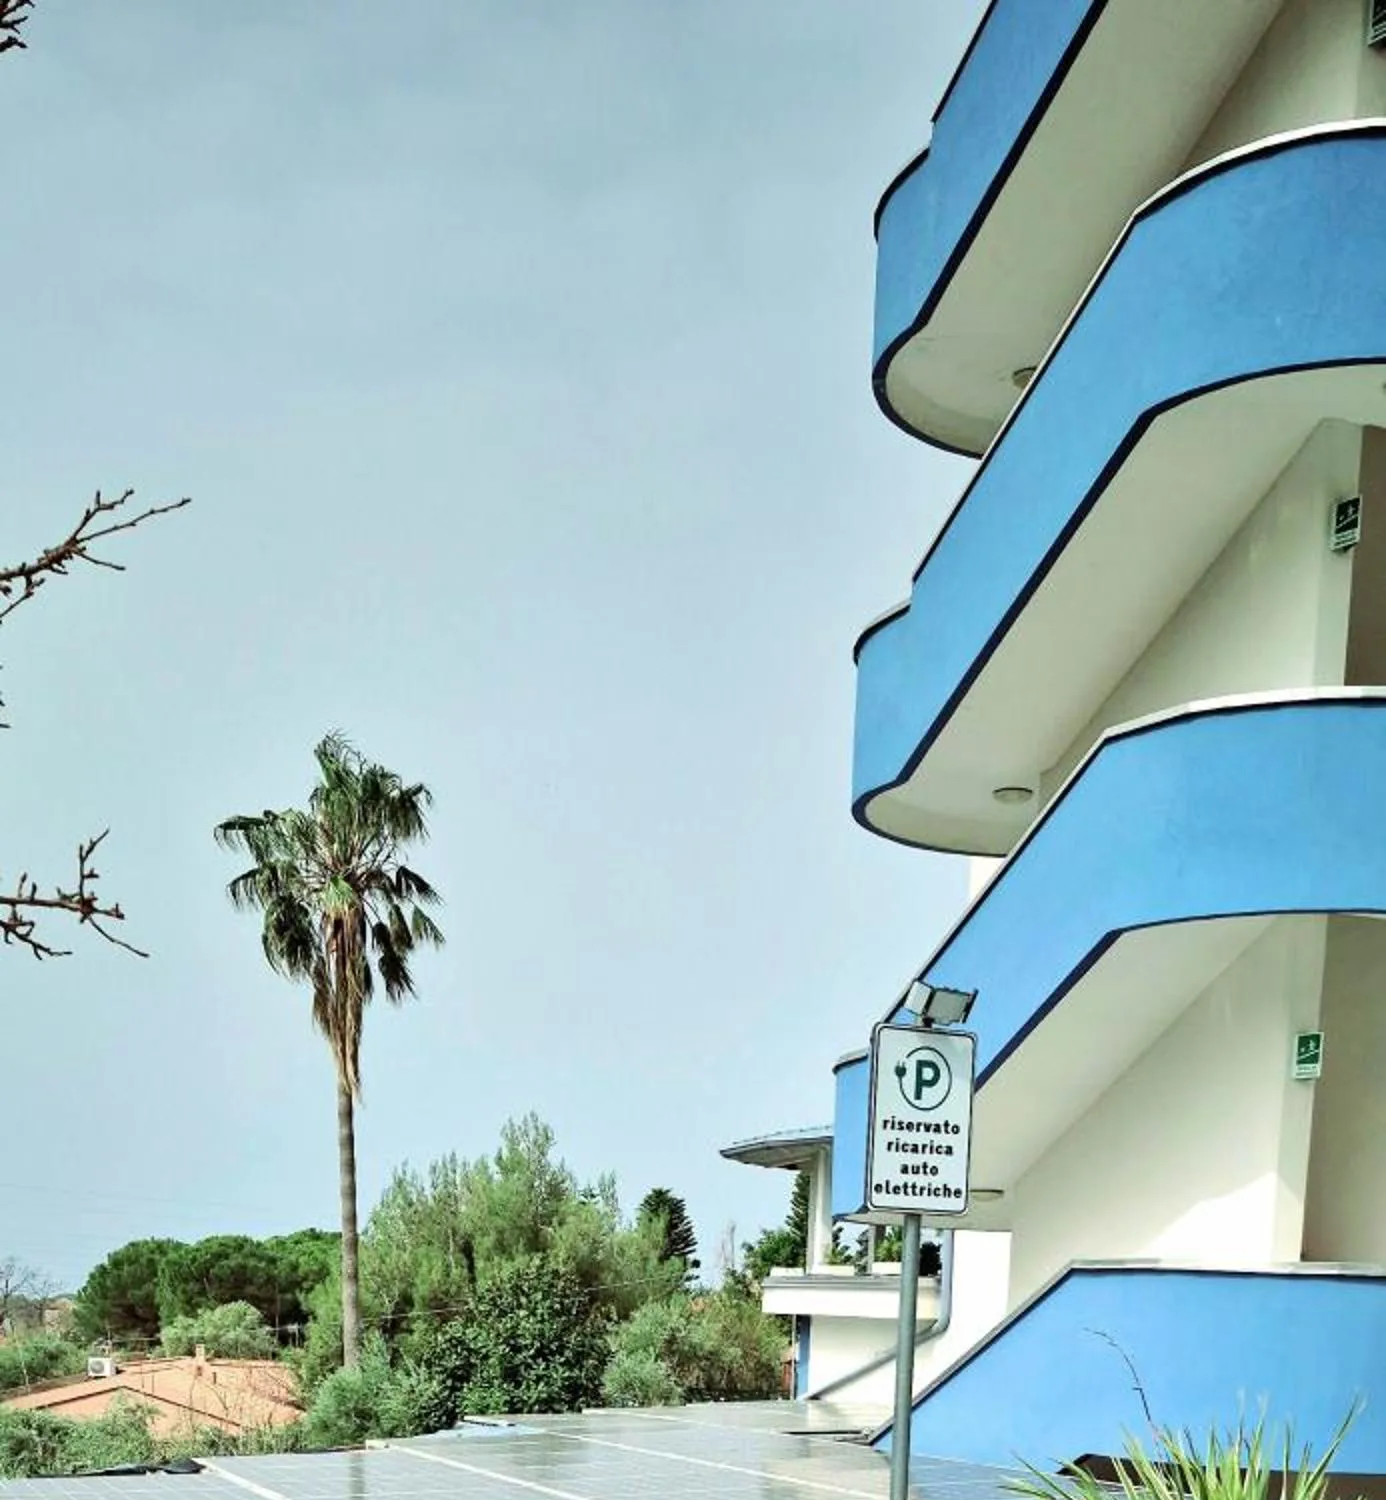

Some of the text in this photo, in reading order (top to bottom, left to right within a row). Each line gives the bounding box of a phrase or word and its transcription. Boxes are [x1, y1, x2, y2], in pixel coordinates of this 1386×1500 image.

[914, 1059, 941, 1101] P
[882, 1115, 961, 1135] riservato
[886, 1138, 954, 1156] ricarica
[900, 1162, 939, 1176] auto
[873, 1180, 963, 1199] elettriche
